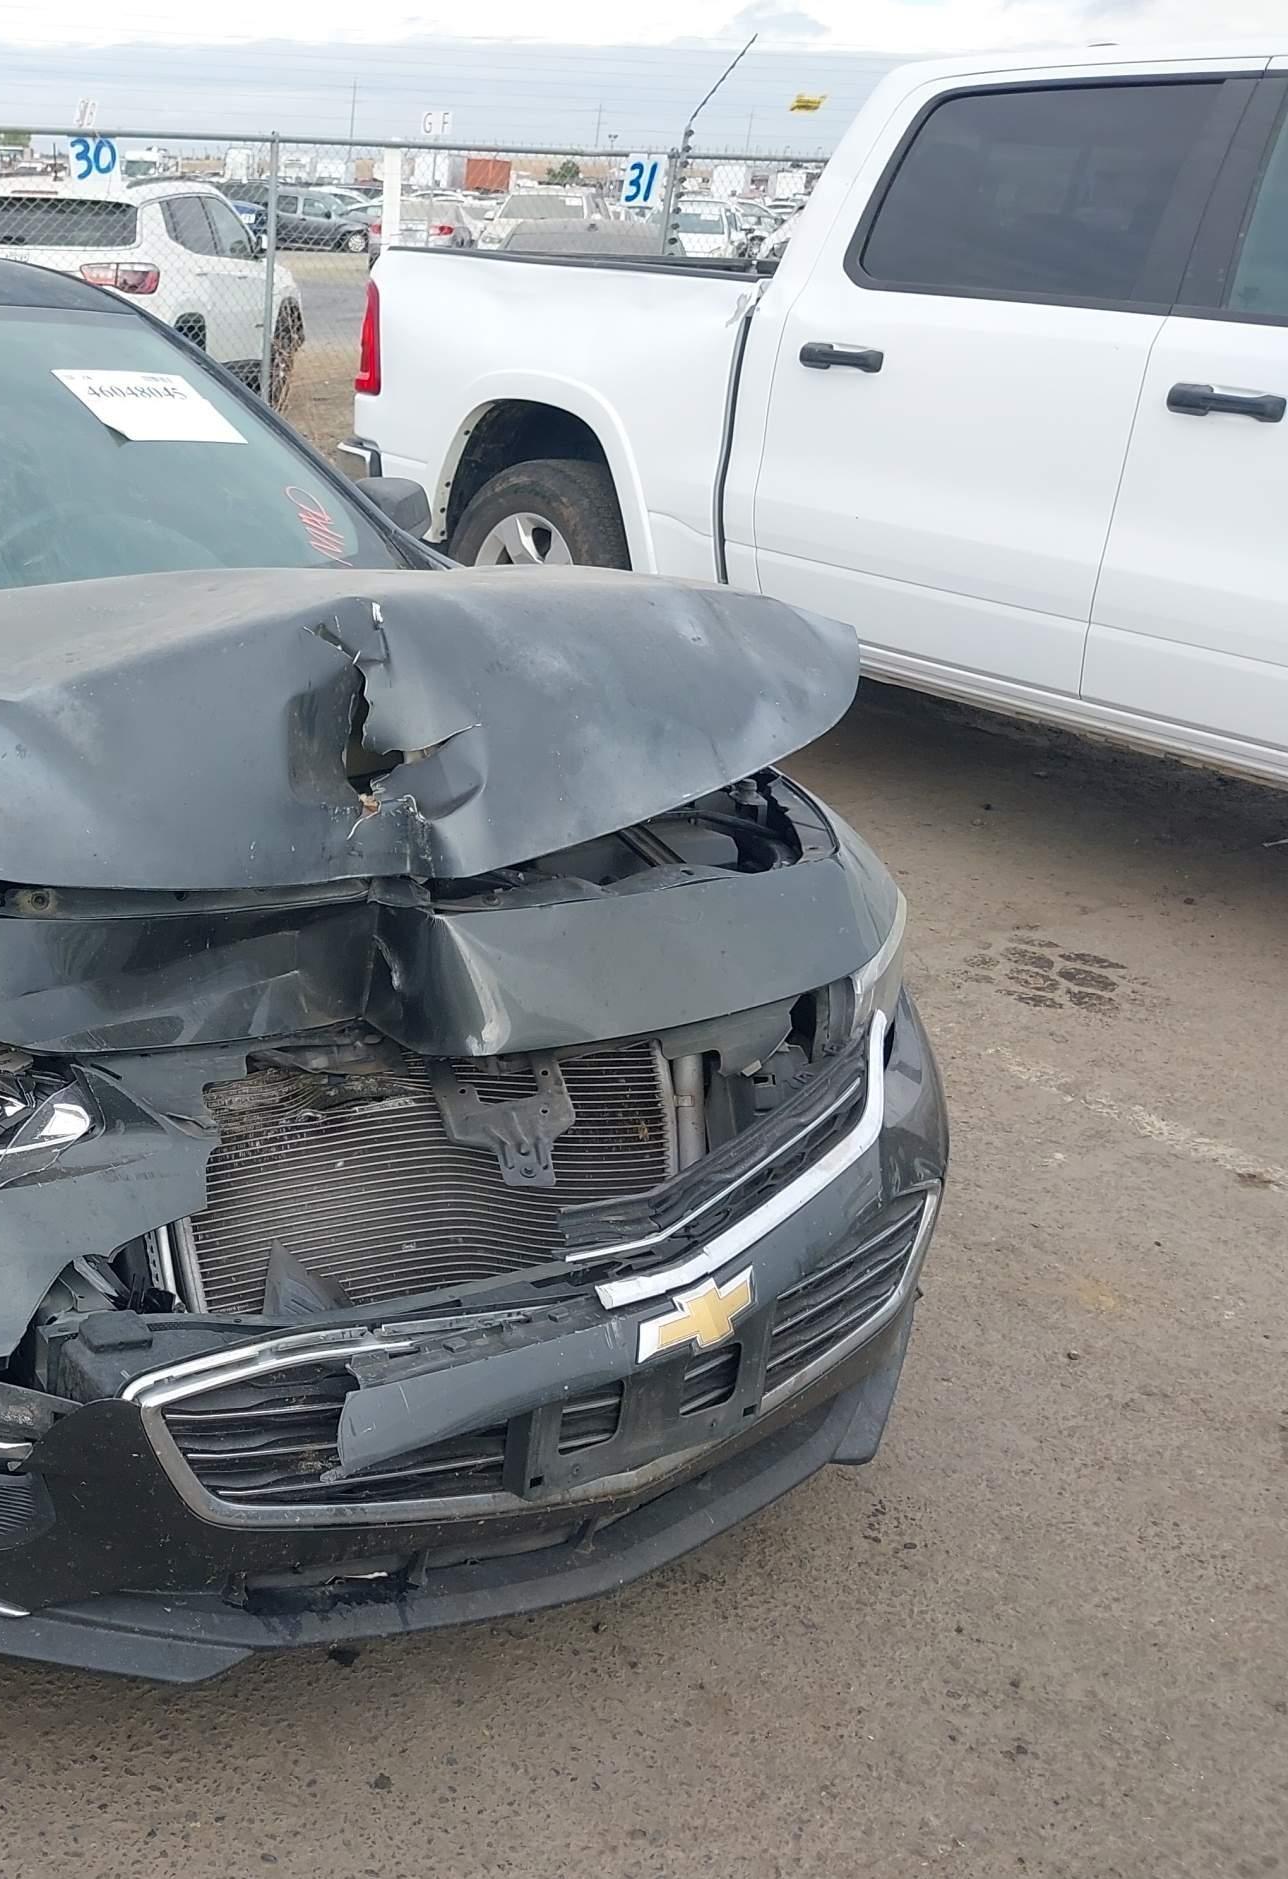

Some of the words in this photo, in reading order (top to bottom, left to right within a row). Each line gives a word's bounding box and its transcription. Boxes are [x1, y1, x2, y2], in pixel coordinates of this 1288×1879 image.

[423, 112, 433, 134] G
[441, 112, 450, 133] F
[70, 137, 117, 180] 30
[624, 161, 658, 202] 31
